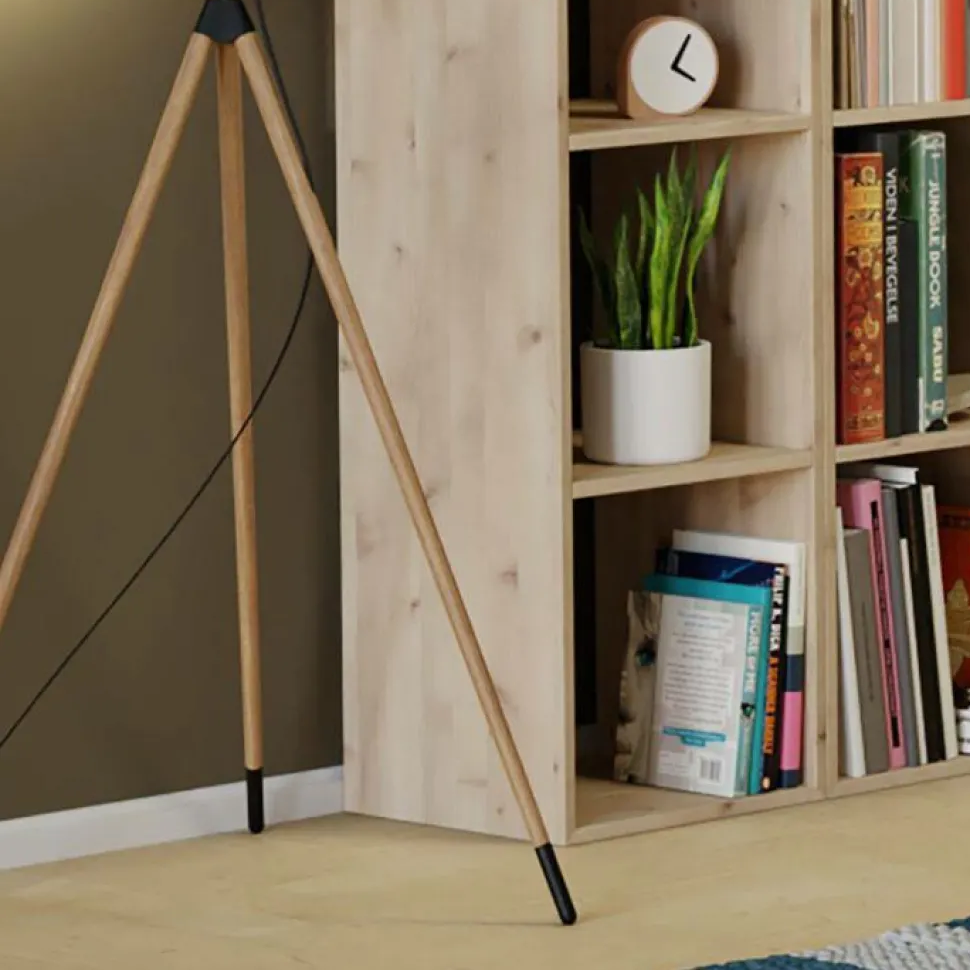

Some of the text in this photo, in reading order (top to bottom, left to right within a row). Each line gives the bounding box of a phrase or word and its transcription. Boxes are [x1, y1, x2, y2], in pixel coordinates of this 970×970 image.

[885, 233, 899, 323] BEVEGELSE
[928, 179, 943, 382] JUNGLE BOOK SABU
